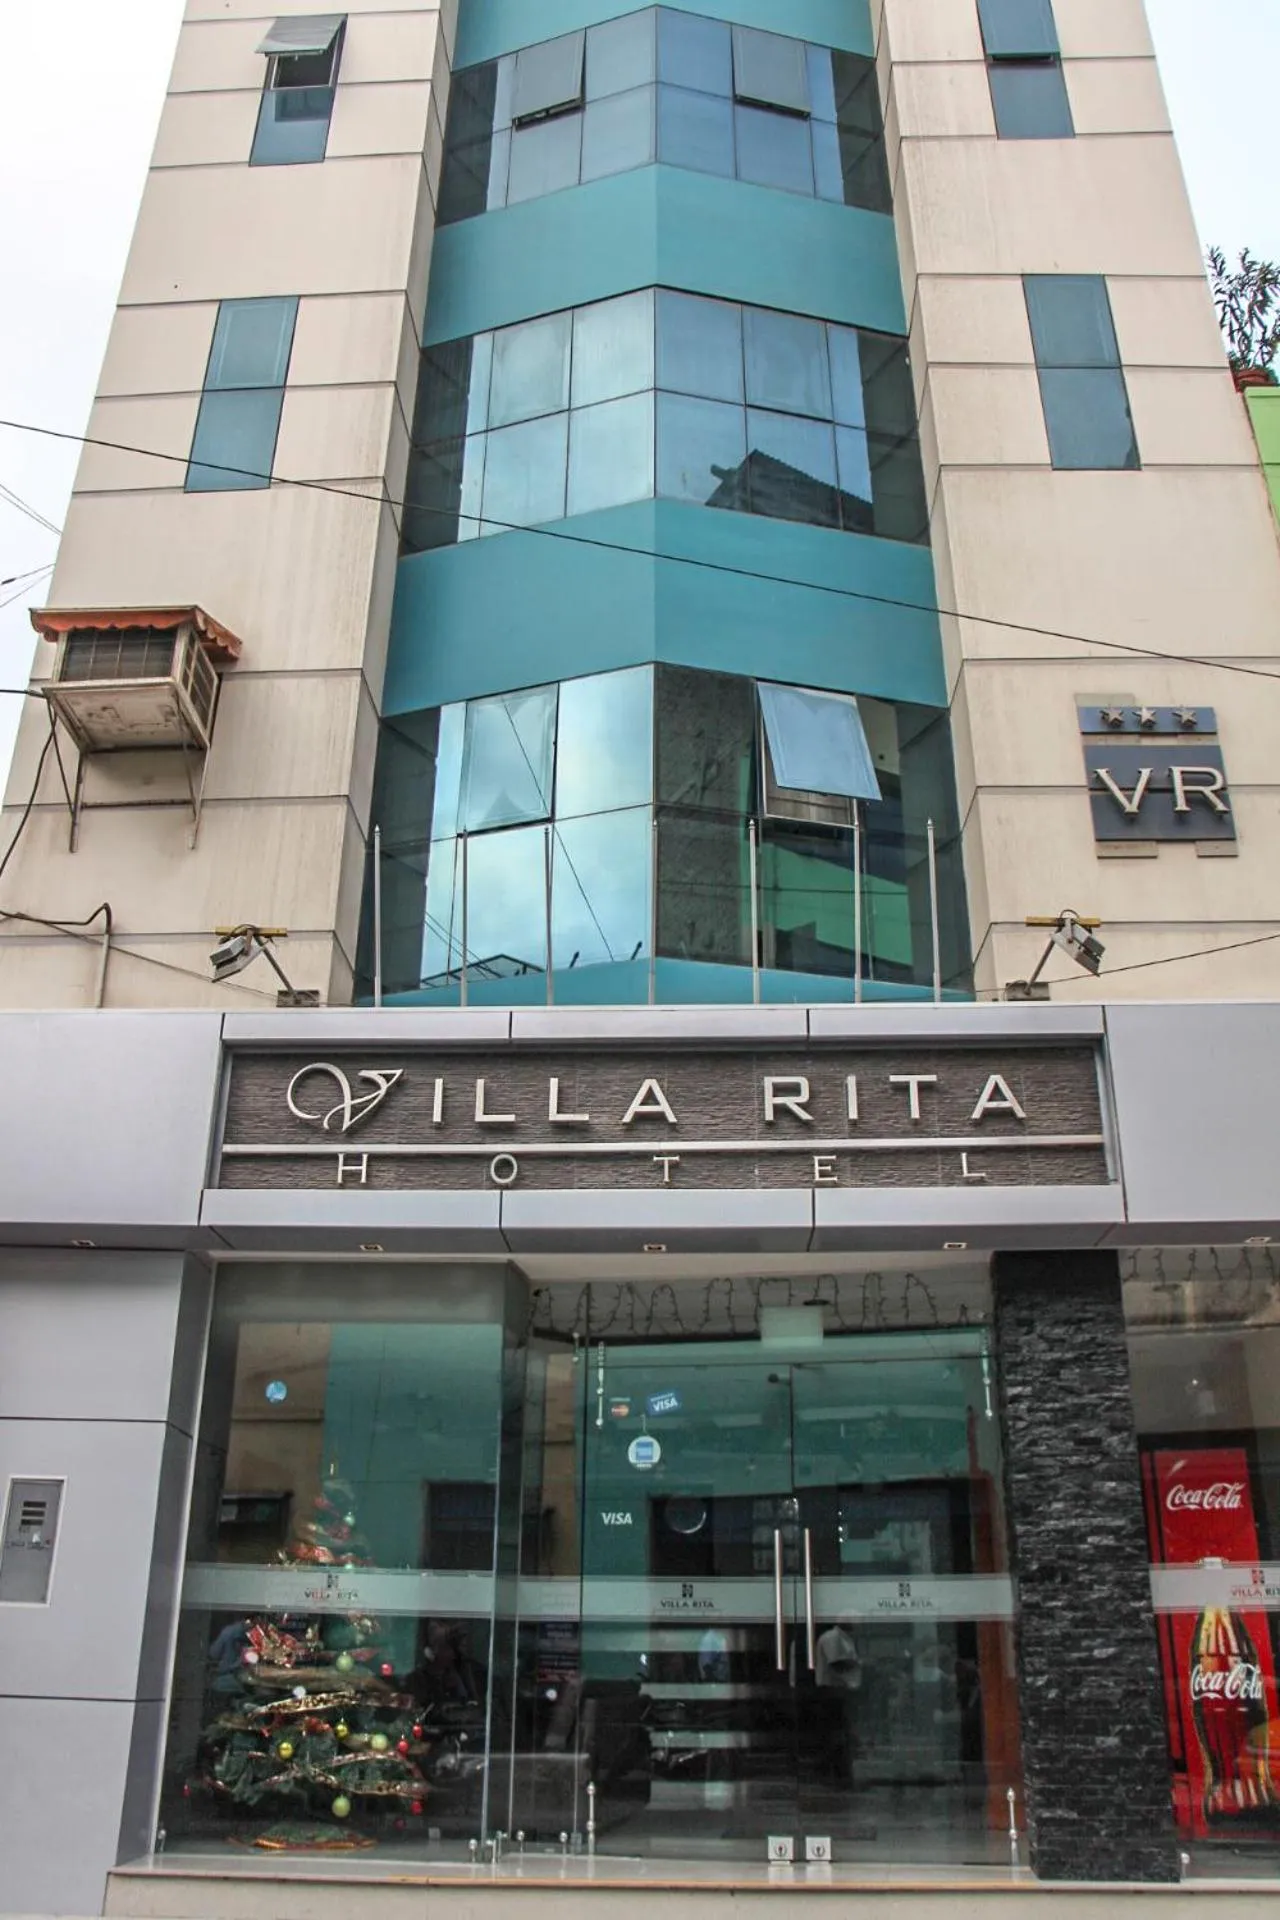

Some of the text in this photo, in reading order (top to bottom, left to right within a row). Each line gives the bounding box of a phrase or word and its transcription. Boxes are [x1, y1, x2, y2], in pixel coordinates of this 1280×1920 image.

[1094, 766, 1231, 815] VR
[287, 1062, 1026, 1132] VILLA RITA
[337, 1151, 986, 1185] HOTEL
[653, 1397, 678, 1412] VISA
[1166, 1482, 1246, 1511] Coca-Cola
[601, 1511, 633, 1526] VISA
[661, 1600, 715, 1609] VILLA RITA
[1191, 1662, 1262, 1700] Coca-Cola
